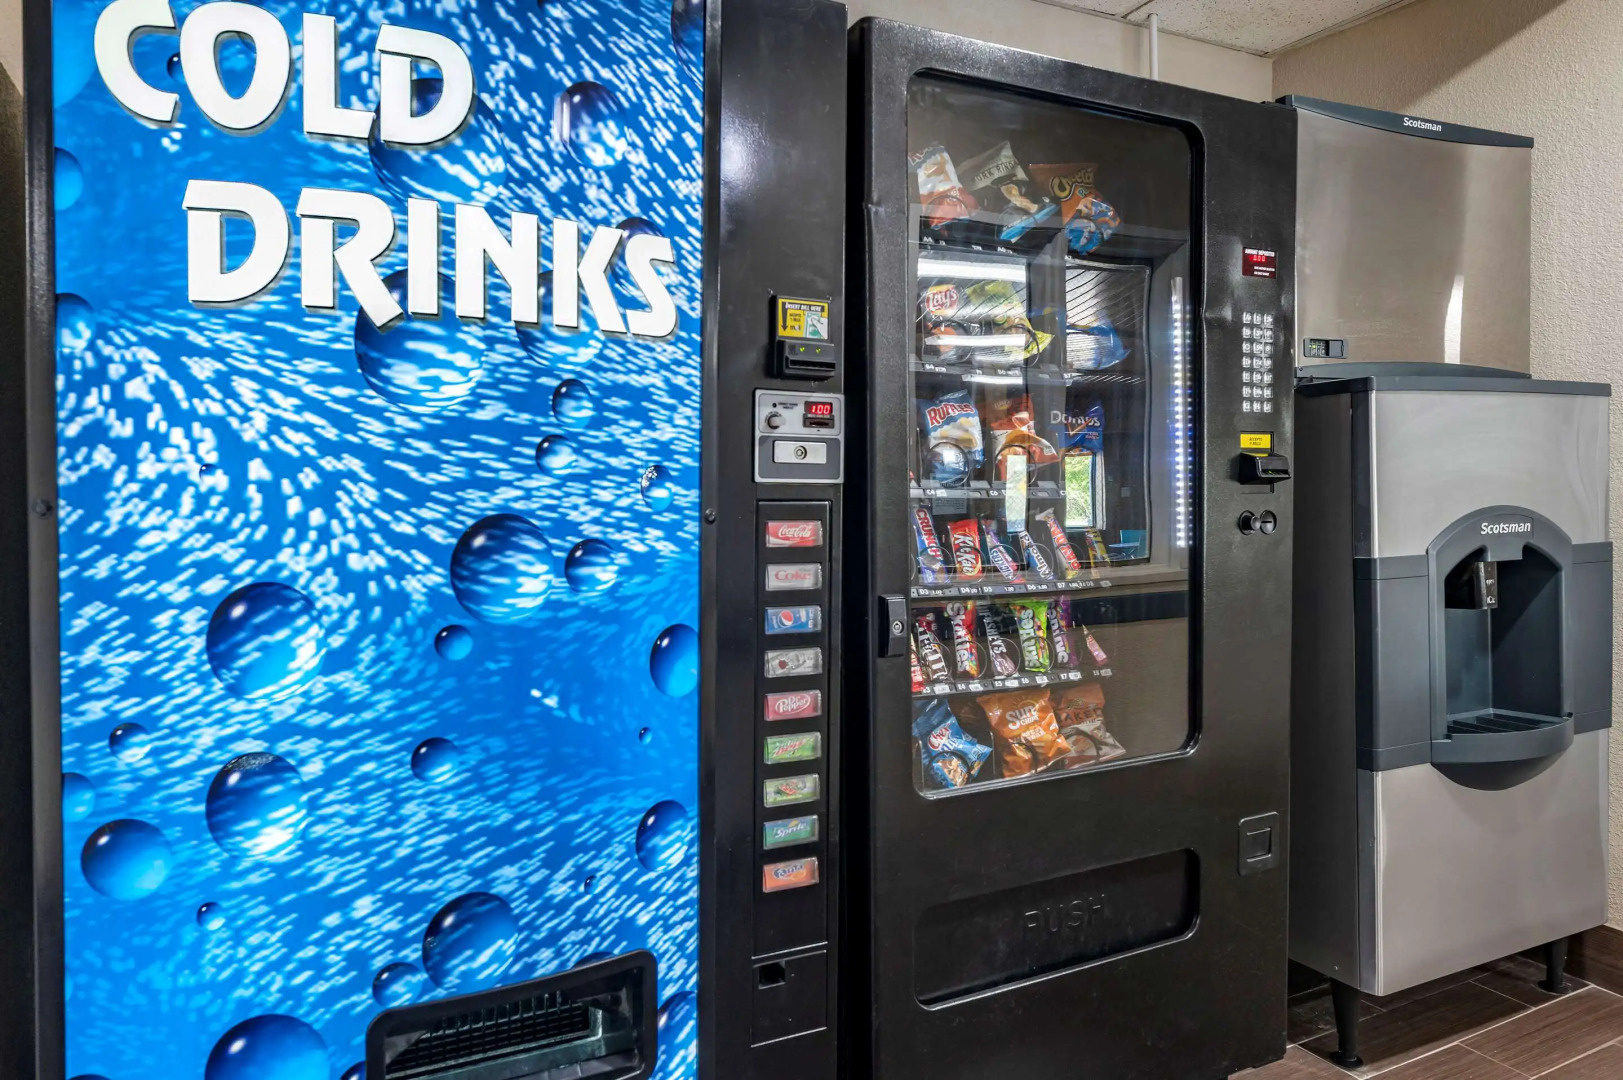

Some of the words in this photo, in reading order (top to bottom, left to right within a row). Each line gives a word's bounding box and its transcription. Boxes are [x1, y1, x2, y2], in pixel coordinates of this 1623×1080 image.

[94, 0, 475, 145] COLD
[1403, 117, 1442, 132] Scotsman
[183, 179, 678, 338] DRINKS
[811, 405, 831, 415] 1.00
[926, 402, 975, 428] RUFFLES
[1050, 410, 1100, 426] Doritos
[914, 507, 944, 561] CRUNCH
[1480, 522, 1531, 535] Scotsman
[778, 698, 807, 713] Pepper
[774, 822, 807, 839] Sprite
[773, 863, 804, 879] Fanta
